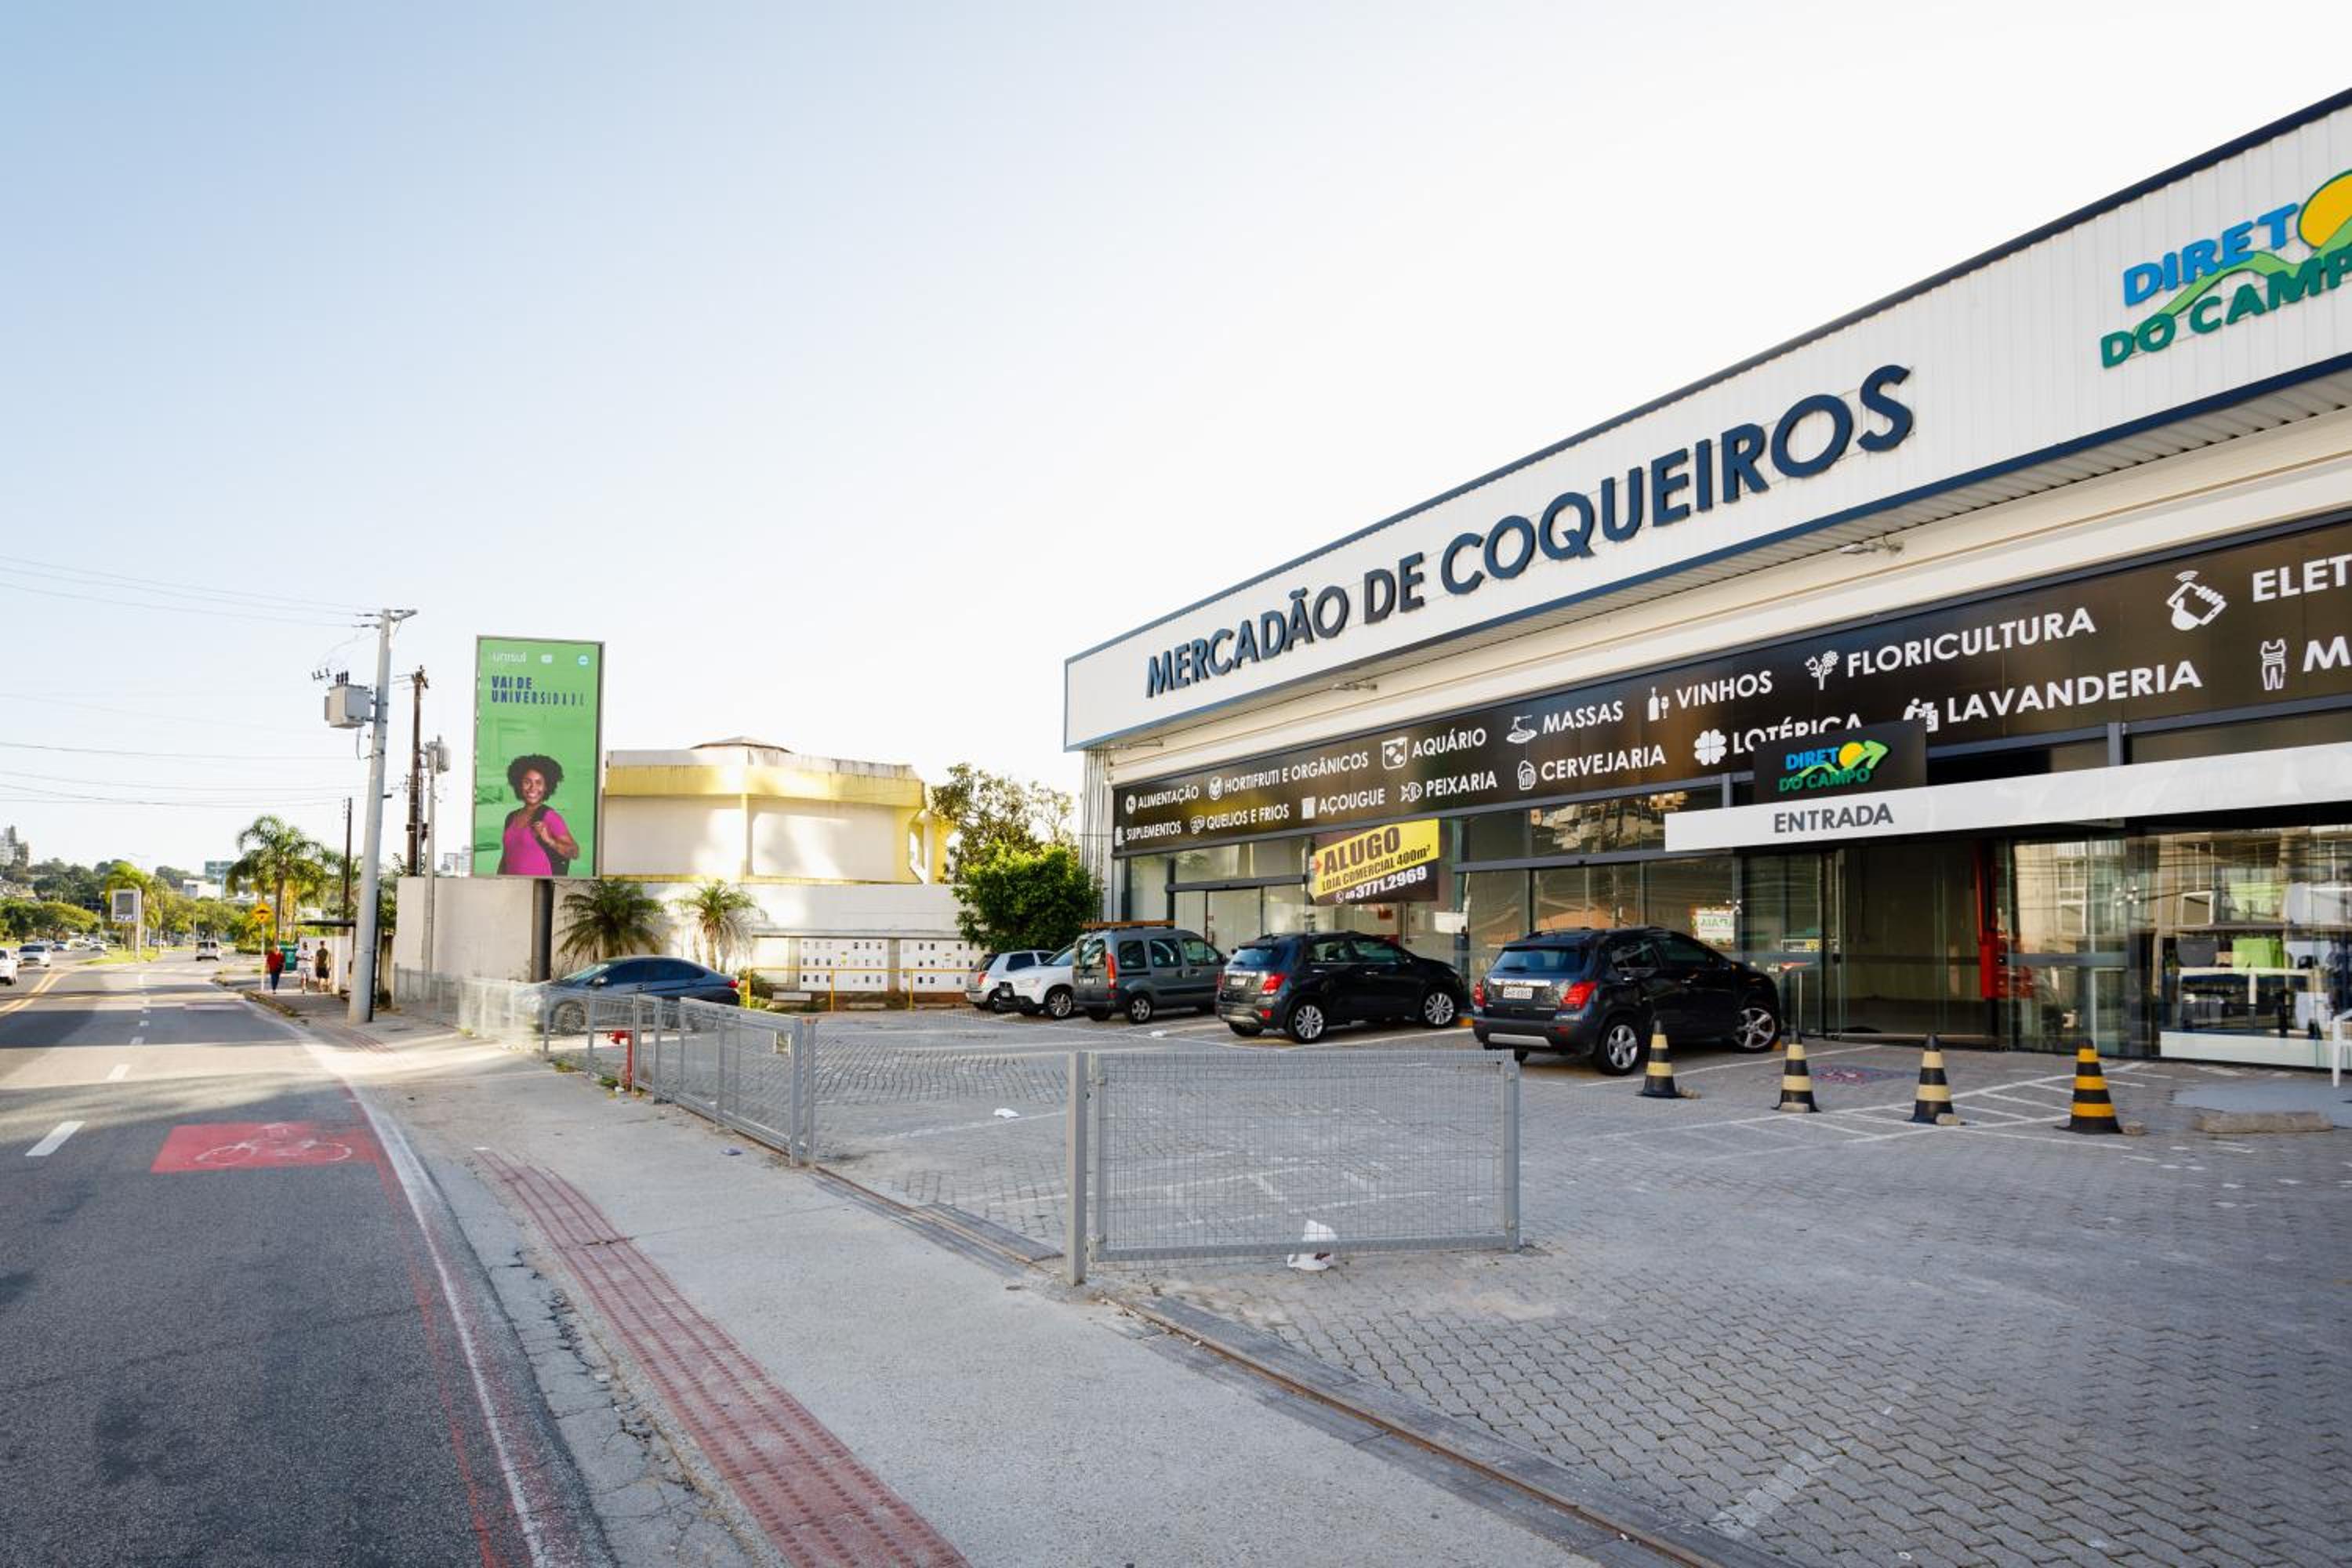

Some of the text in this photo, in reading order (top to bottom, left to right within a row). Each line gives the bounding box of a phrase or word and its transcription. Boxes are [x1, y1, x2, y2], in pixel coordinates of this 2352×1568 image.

[2100, 313, 2176, 368] DO
[1145, 365, 1914, 698] MERCADÃO DE COQUEIROS
[1847, 608, 2096, 678] FLORICULTURA
[492, 676, 532, 689] VAI DE
[1675, 670, 1773, 709] VINHOS
[1948, 660, 2202, 724] LAVANDERIA
[1542, 700, 1624, 735] MASSAS
[1412, 728, 1486, 758] AQUÁRIO
[1224, 751, 1369, 793] HORTIFRUTI E ORGÂNICOS
[1541, 745, 1666, 782] CERVEJARIA
[1778, 767, 1871, 792] DO CAMPO
[1138, 785, 1200, 810] ALIMENTAÇÃO
[1426, 771, 1498, 797] PEIXARIA
[1207, 804, 1290, 831] QUEIJOS E FRIOS
[1318, 788, 1385, 815] AÇOUGUE
[1774, 803, 1893, 833] ENTRADA
[1126, 821, 1181, 841] SUPLEMENTOS
[1323, 826, 1401, 876] ALUGO
[1322, 876, 1341, 891] LOJA
[1343, 858, 1395, 884] COMERCIAL
